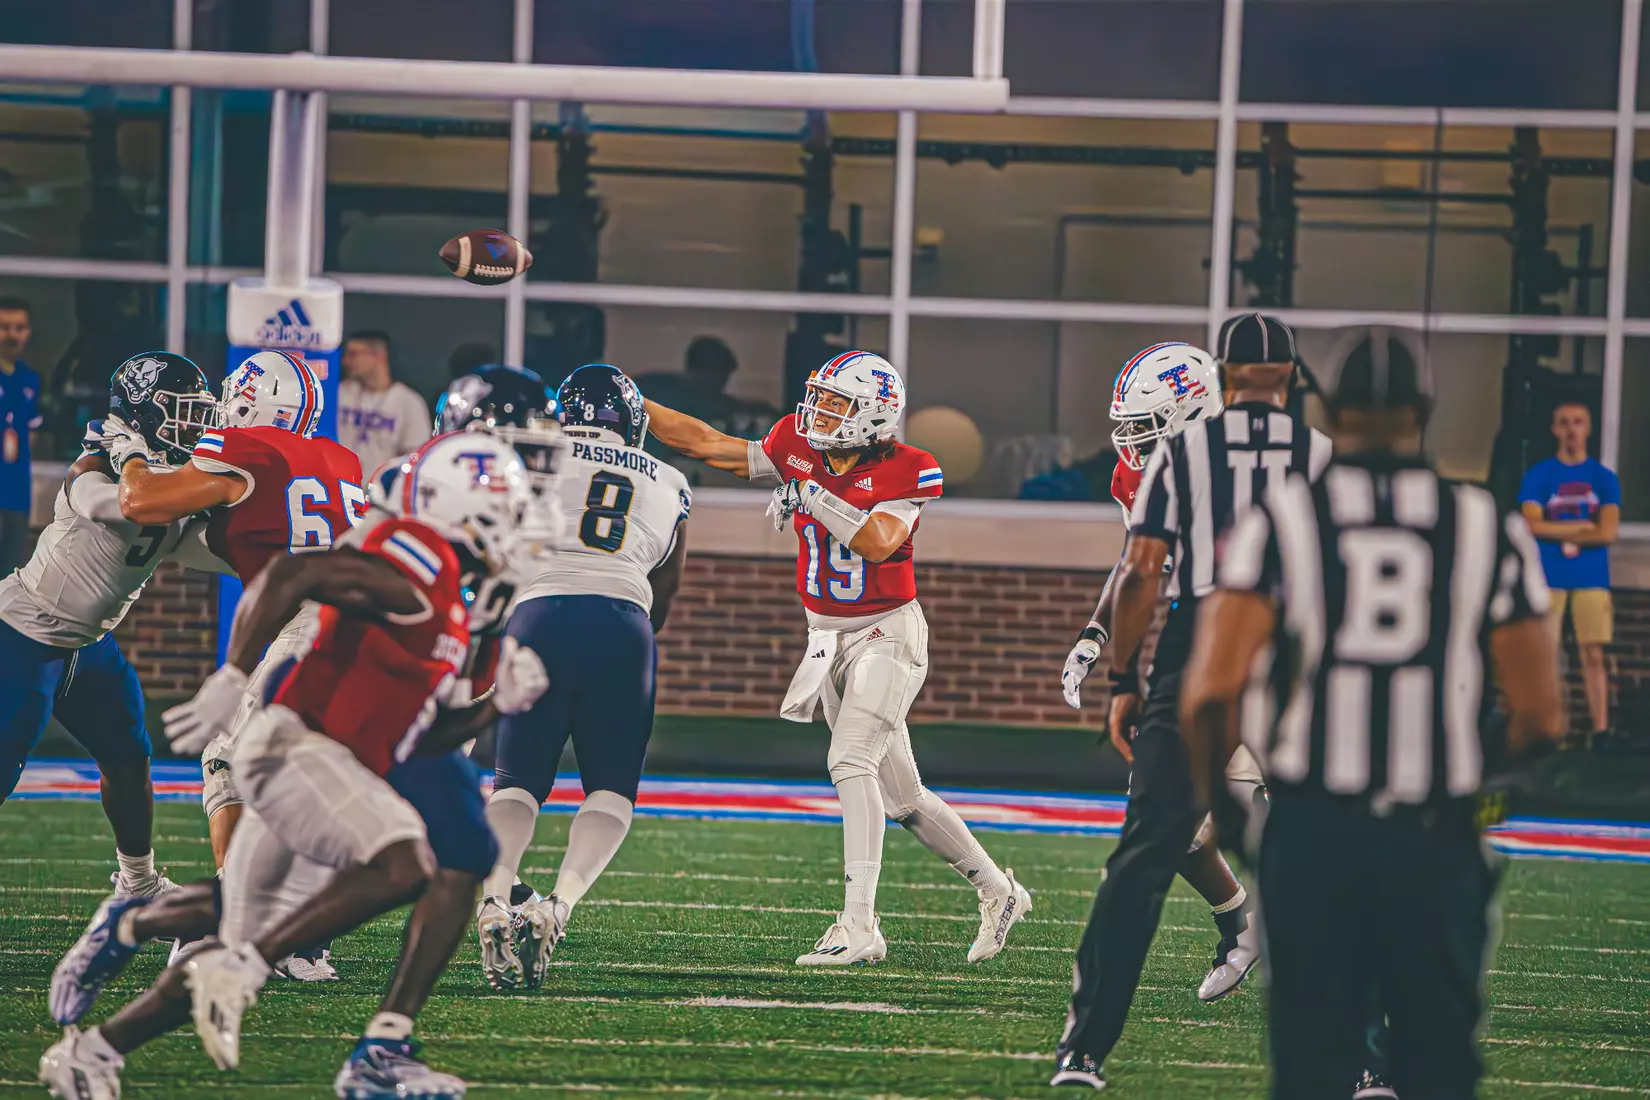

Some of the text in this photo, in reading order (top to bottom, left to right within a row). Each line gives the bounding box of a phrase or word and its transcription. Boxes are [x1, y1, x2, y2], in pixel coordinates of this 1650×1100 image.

[583, 403, 595, 421] 8
[572, 442, 658, 482] PASSMORE
[284, 476, 365, 555] 65
[578, 470, 637, 554] 8
[802, 522, 867, 603] 19
[1332, 526, 1435, 666] B
